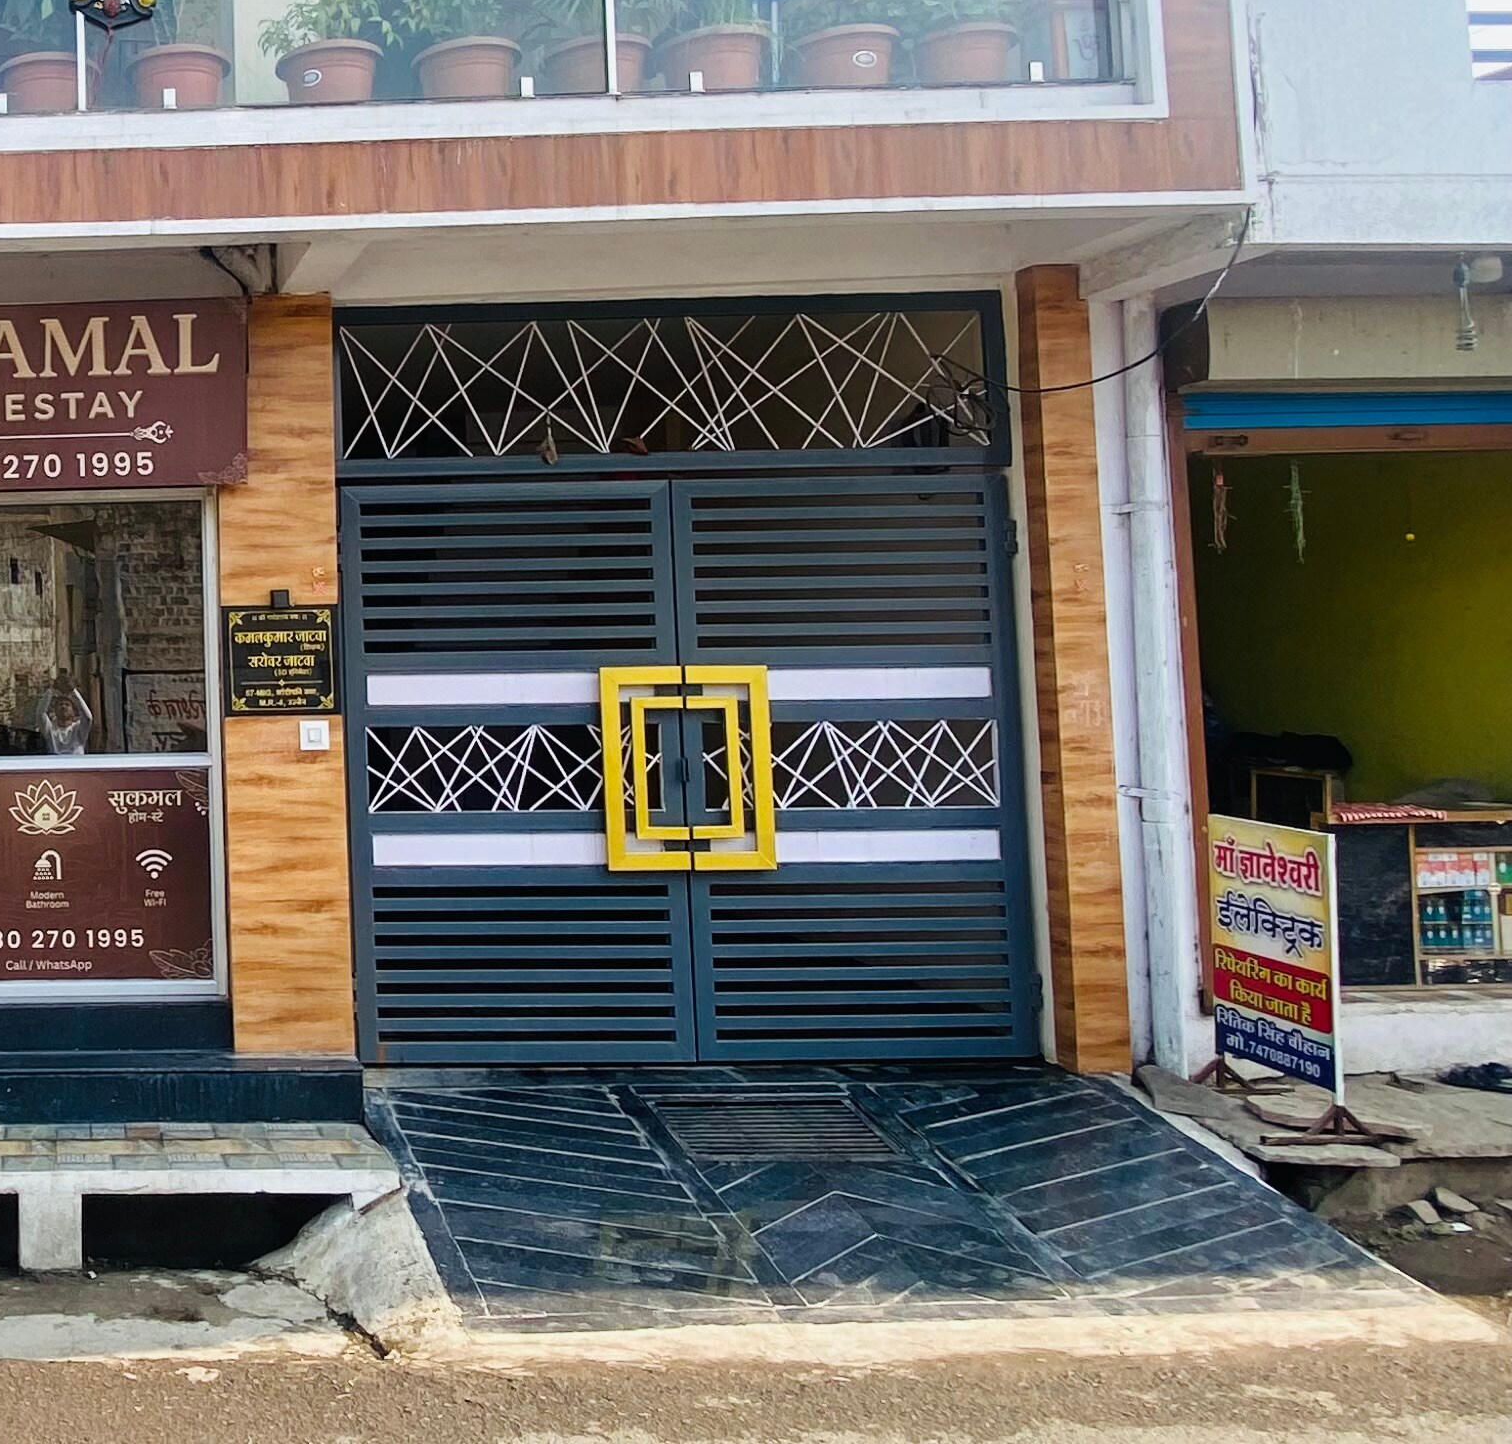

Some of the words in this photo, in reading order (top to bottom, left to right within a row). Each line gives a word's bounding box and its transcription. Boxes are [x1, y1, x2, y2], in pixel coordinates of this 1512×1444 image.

[3, 453, 62, 479] 270
[76, 451, 155, 477] 1995
[233, 631, 294, 647] कमलकुमार
[107, 789, 183, 814] सुकमल
[1239, 842, 1320, 892] ज्ञानेश्वरी
[30, 891, 65, 899] Modern
[145, 889, 165, 897] Free
[26, 900, 69, 908] Bathroom
[31, 929, 76, 949] 270
[86, 928, 144, 948] 1995
[5, 960, 27, 970] Call
[37, 959, 92, 971] WhatsApp
[1272, 971, 1293, 990] का
[1295, 977, 1327, 1000] कार्य
[1230, 979, 1263, 1008] किया
[1265, 996, 1298, 1020] जाता
[1301, 1001, 1312, 1025] है
